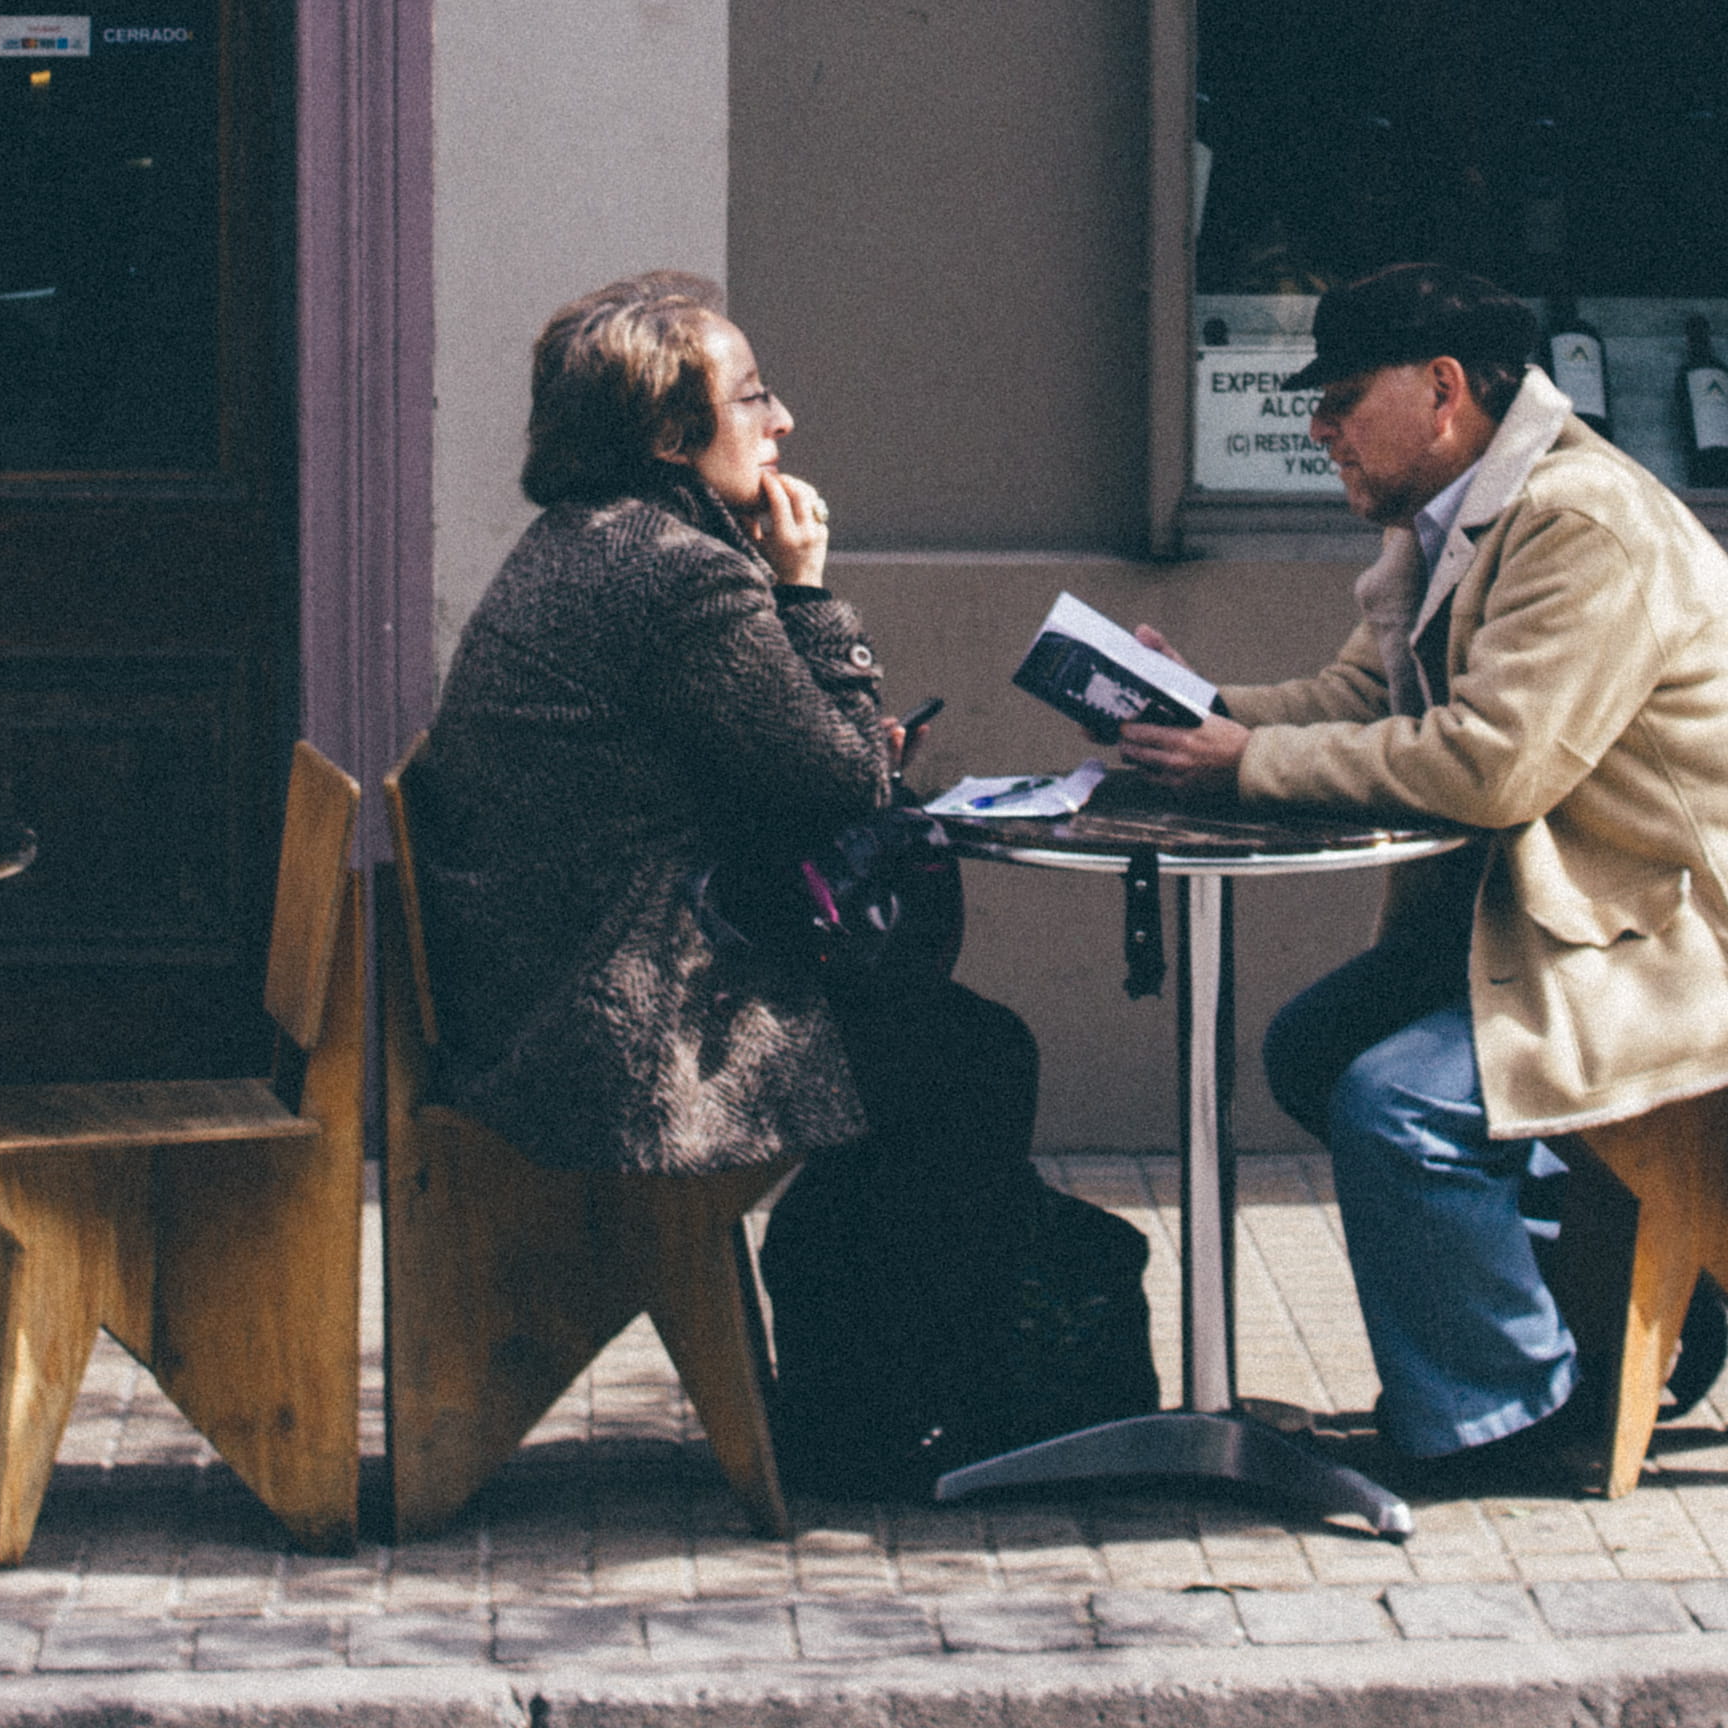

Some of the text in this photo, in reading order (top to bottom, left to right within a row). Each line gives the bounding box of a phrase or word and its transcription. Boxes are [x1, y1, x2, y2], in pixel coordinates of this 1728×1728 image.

[103, 27, 189, 44] CERRADO
[1261, 396, 1324, 418] ALCO
[1227, 433, 1330, 457] (C) RESTAU
[1284, 456, 1339, 476] Y NOC
